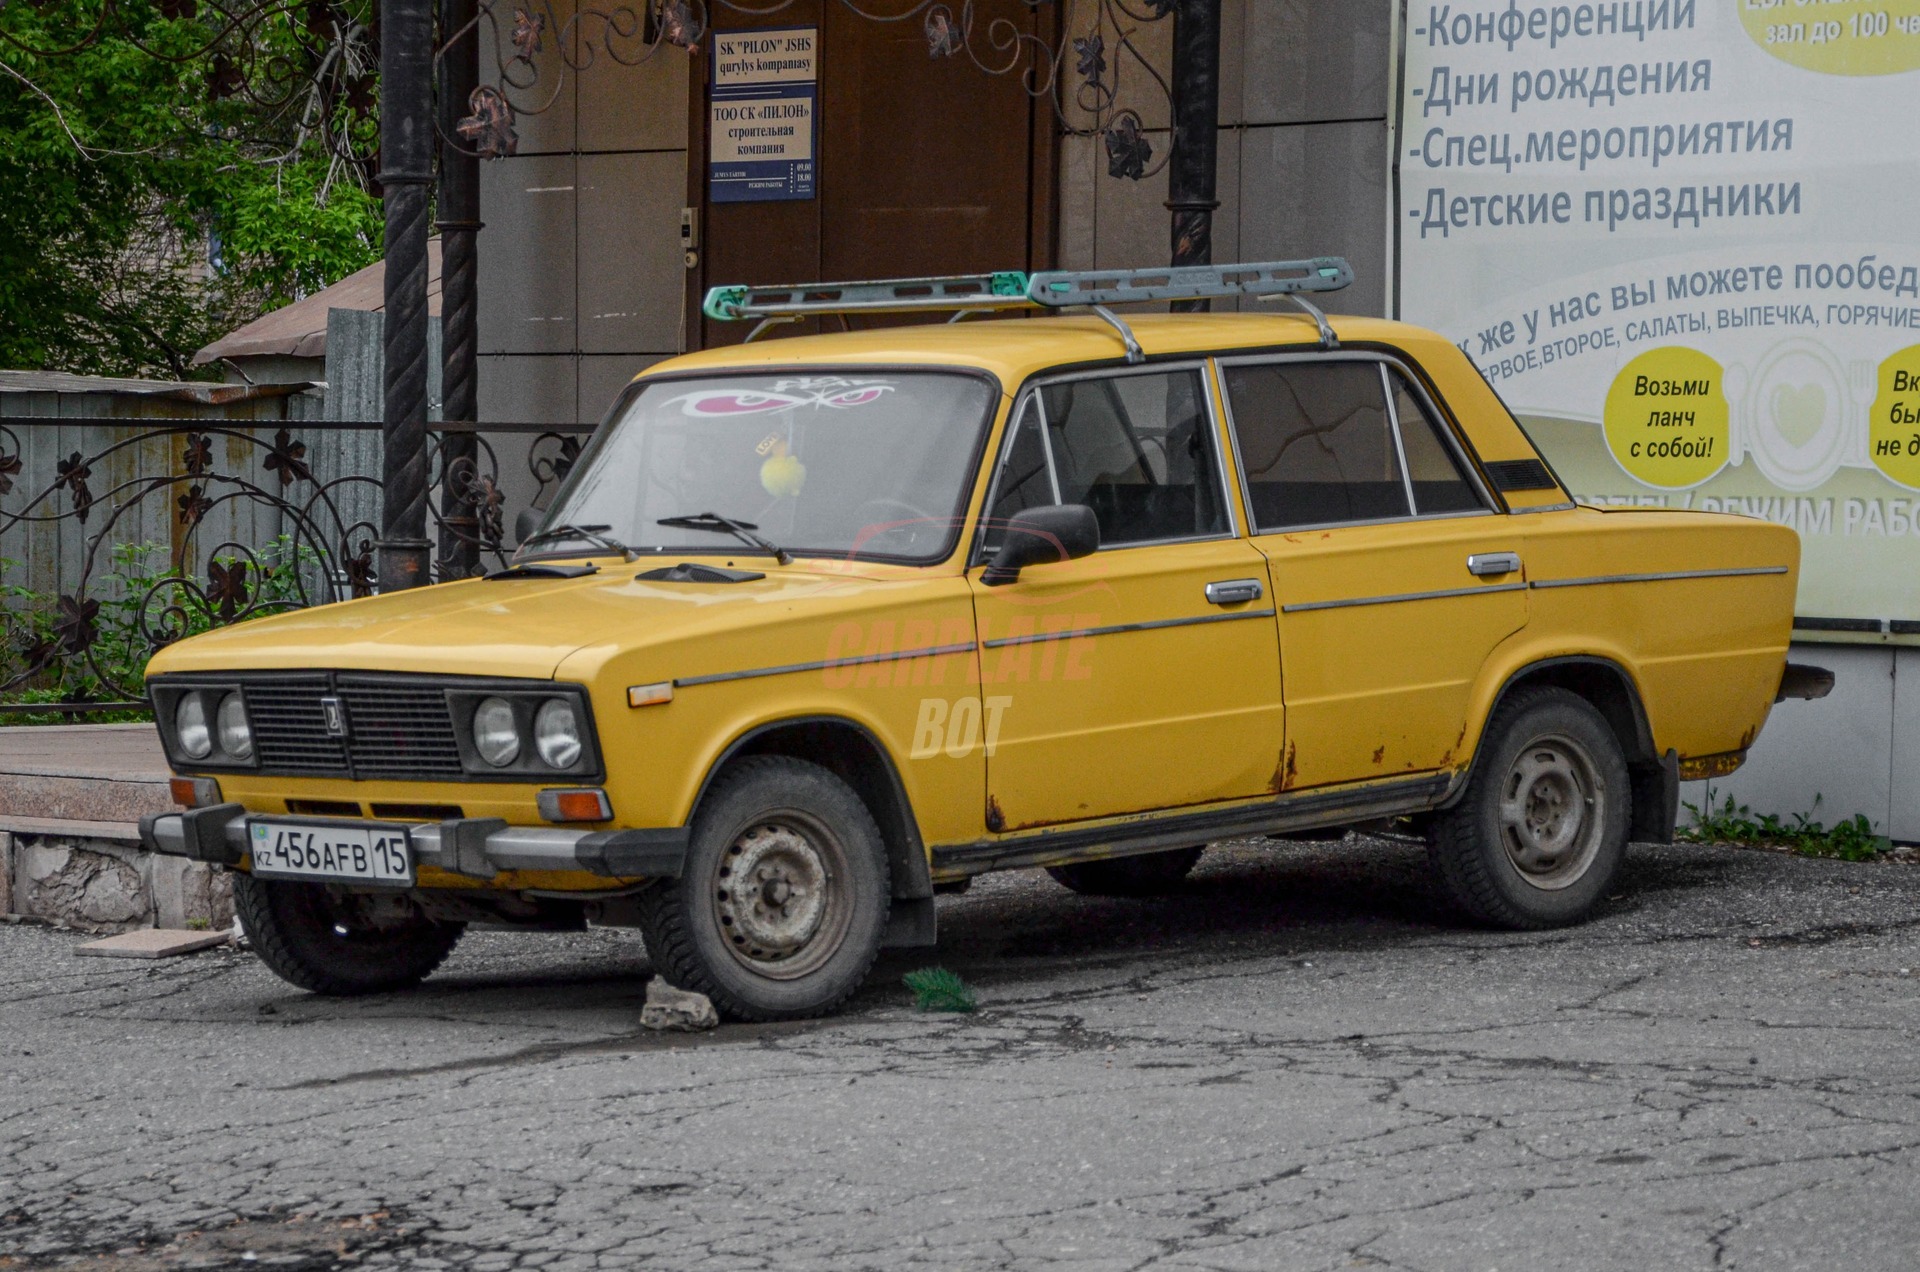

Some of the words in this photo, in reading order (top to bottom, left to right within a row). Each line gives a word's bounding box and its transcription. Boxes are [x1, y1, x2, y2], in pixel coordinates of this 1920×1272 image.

[1415, 0, 1696, 51] -Конференции
[1766, 23, 1806, 44] зал
[1811, 21, 1842, 44] до
[1849, 11, 1889, 38] 100
[720, 41, 735, 56] SK
[738, 38, 783, 54] "PILON"
[785, 37, 812, 52] JSHS
[720, 58, 755, 76] qurylys
[1413, 66, 1499, 118] -Дни
[1512, 59, 1712, 112] рождения
[714, 107, 738, 121] ТОО
[740, 106, 755, 121] СК
[757, 104, 810, 120] «ПИЛОН»
[728, 125, 794, 140] строительная
[737, 144, 785, 156] компания
[1409, 118, 1794, 175] -Спец.мероприятия
[1409, 187, 1572, 238] -Детские
[1585, 181, 1801, 231] праздники
[1478, 318, 1515, 355] же
[1523, 310, 1539, 345] у
[1549, 291, 1602, 328] нас
[1611, 279, 1656, 311] вы
[1667, 264, 1783, 301] можете
[1795, 255, 1919, 298] пообед
[1626, 311, 1711, 342] САЛАТЫ,
[1717, 304, 1820, 329] ВЫПЕЧКА,
[1827, 304, 1920, 329] ГОРЯЧИЕ
[1634, 375, 1710, 396] Возьми
[1647, 410, 1696, 427] ланч
[1630, 442, 1641, 457] с
[1647, 437, 1713, 458] собой!
[1876, 440, 1901, 456] не
[256, 851, 272, 866] KZ
